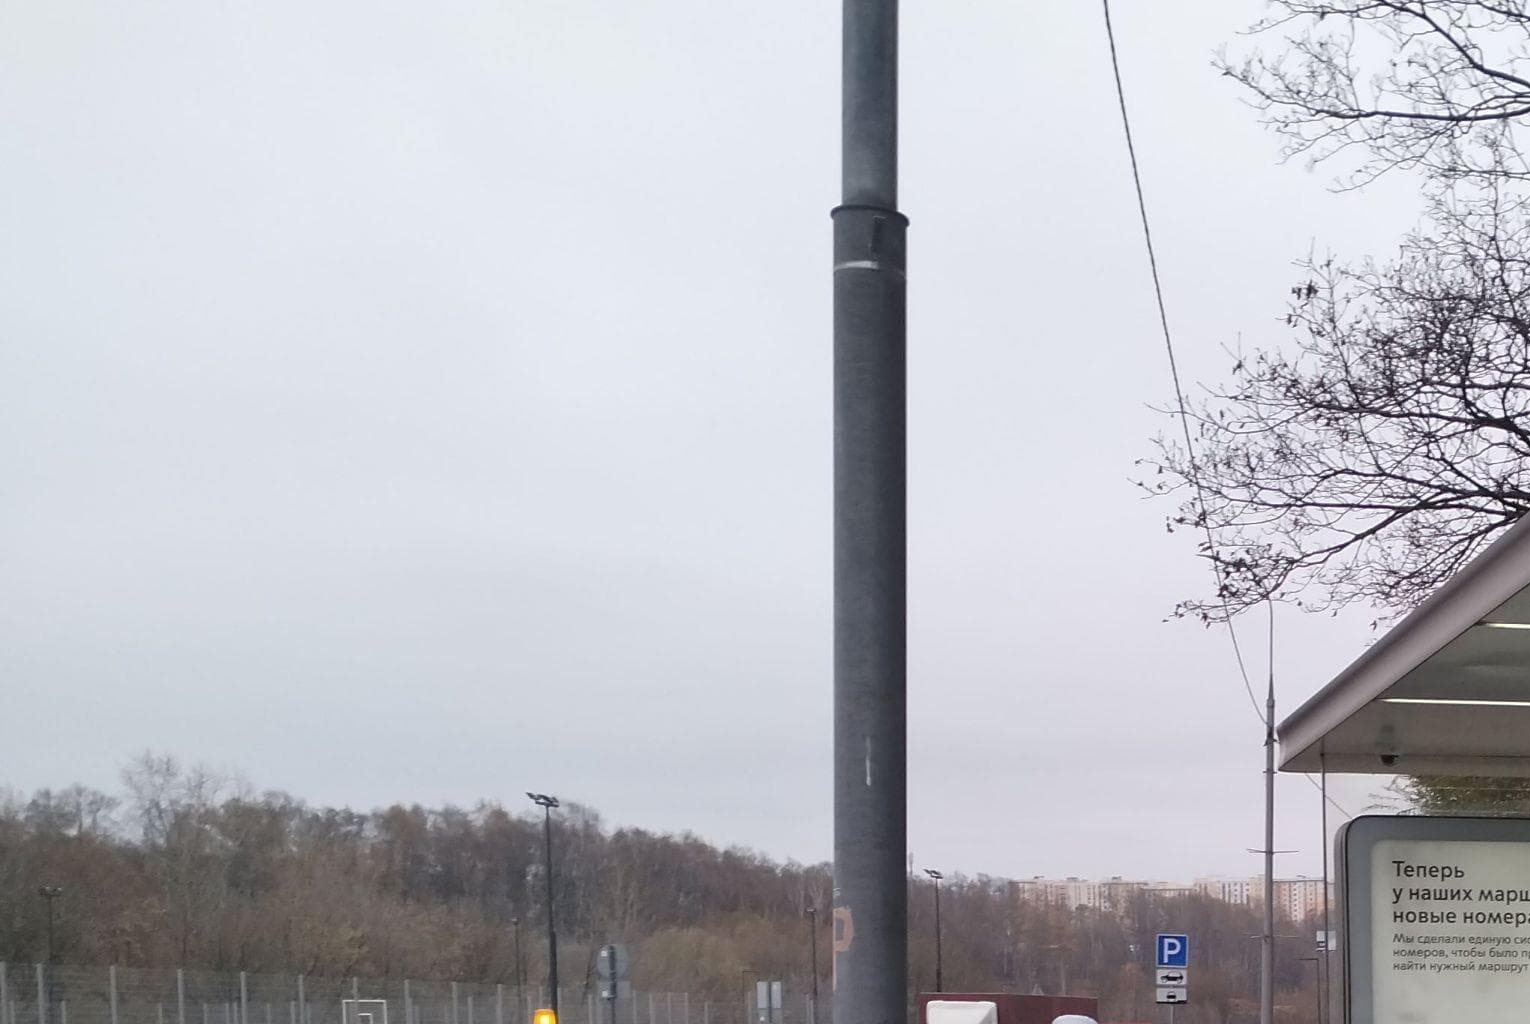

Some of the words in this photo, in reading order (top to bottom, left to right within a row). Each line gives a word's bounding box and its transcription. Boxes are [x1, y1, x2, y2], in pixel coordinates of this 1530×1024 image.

[1391, 860, 1466, 882] Теперь
[1392, 886, 1404, 904] у
[1408, 887, 1474, 902] наших
[1392, 910, 1457, 924] новые
[1393, 933, 1415, 944] Мы
[1417, 935, 1466, 945] сделали
[1468, 936, 1512, 947] единую
[1162, 937, 1182, 964] P
[1392, 948, 1449, 960] номеров,
[1450, 947, 1487, 959] чтобы
[1488, 946, 1519, 958] было
[1392, 960, 1427, 971] найти
[1429, 960, 1476, 974] нужный
[1478, 963, 1530, 974] маршрут
